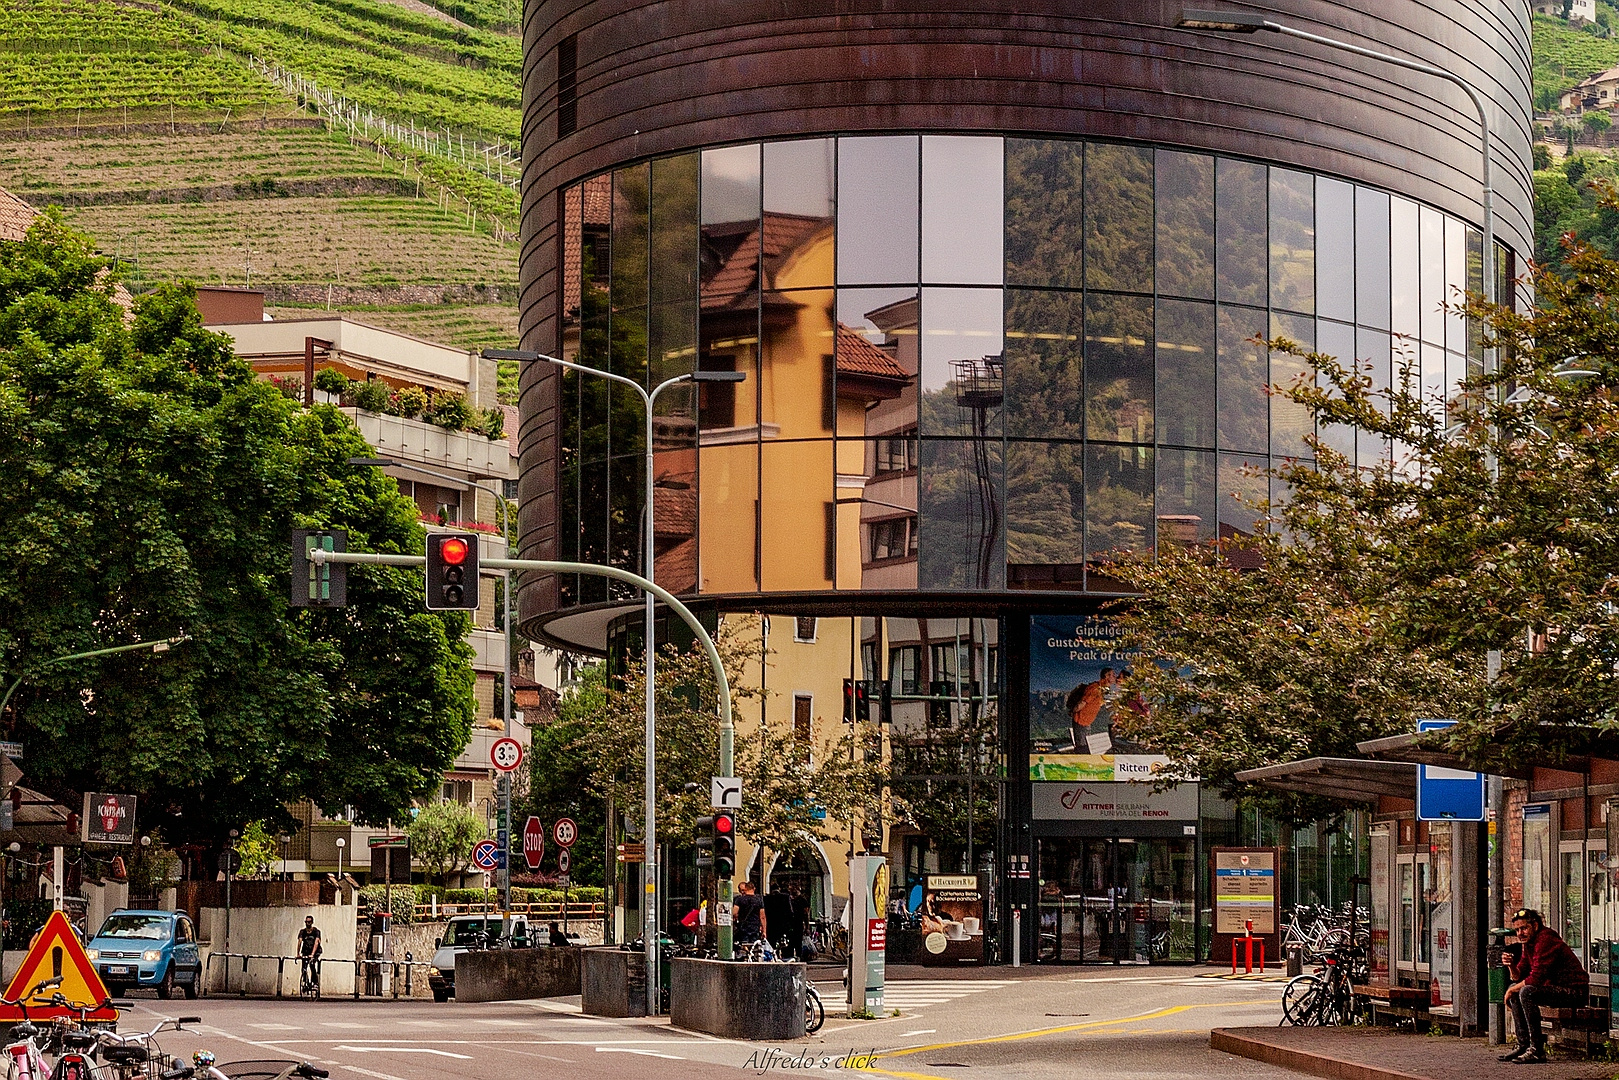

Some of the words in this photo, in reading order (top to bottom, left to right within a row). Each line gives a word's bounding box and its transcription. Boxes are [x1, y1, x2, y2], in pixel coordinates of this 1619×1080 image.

[1047, 637, 1080, 648] Gusto
[1070, 650, 1097, 660] Peak
[1100, 650, 1112, 661] of
[1119, 763, 1149, 773] Ritten
[525, 833, 543, 851] STOP
